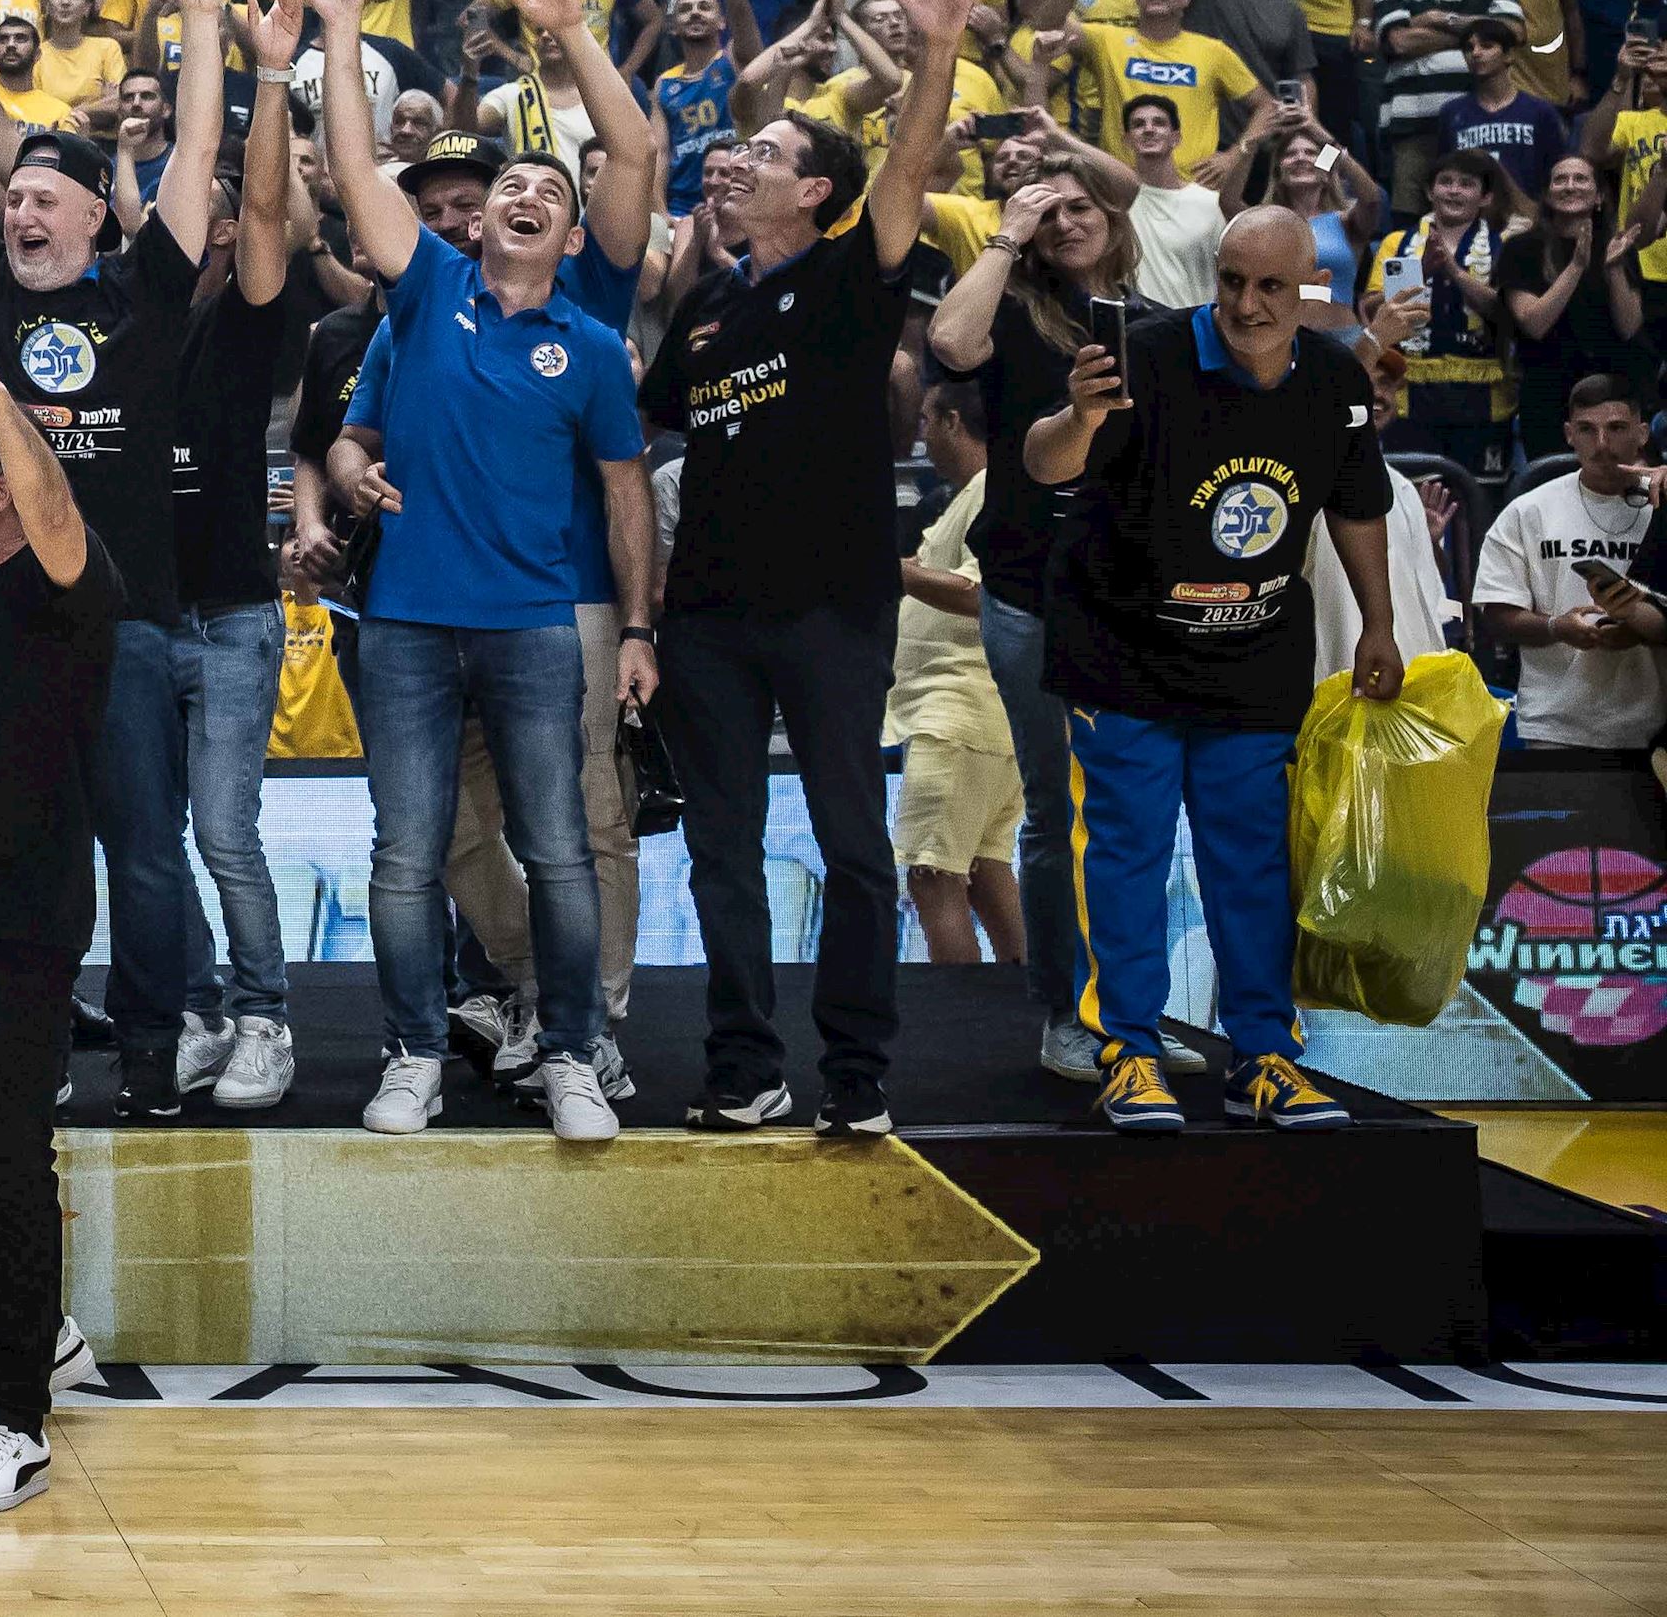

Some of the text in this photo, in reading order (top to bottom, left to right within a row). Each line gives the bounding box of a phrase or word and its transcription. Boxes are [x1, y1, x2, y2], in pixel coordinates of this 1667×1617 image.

[1129, 62, 1192, 85] FOX
[1456, 122, 1535, 151] HORNETS
[79, 406, 121, 425] אלופת
[1230, 457, 1292, 484] PLAYTIKA
[1202, 602, 1268, 623] 2023/24
